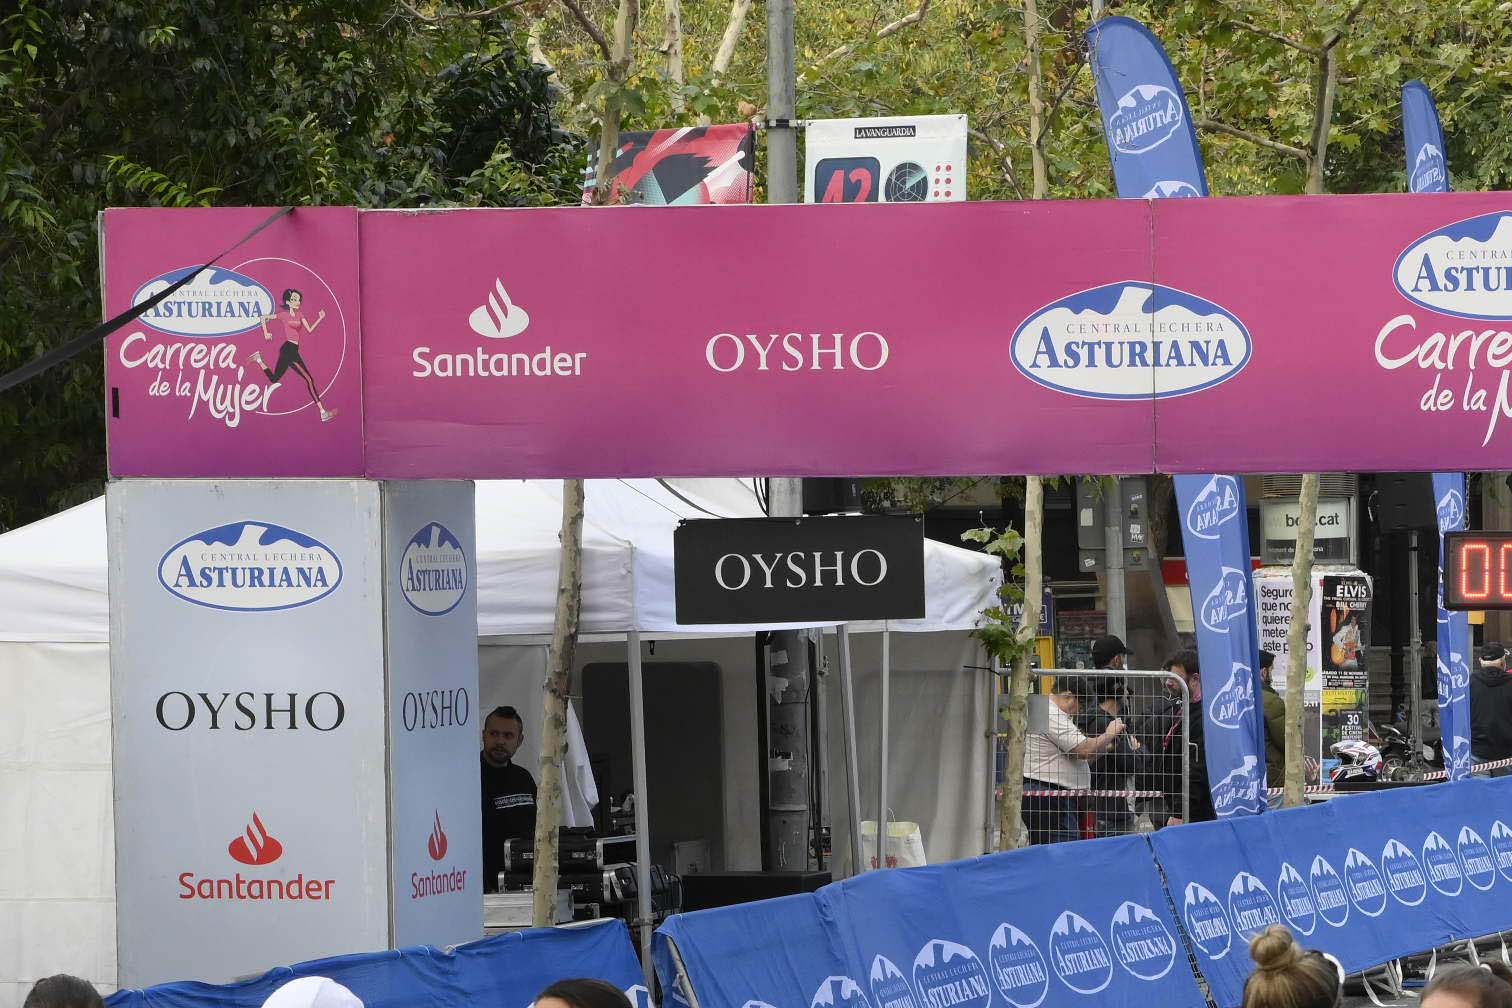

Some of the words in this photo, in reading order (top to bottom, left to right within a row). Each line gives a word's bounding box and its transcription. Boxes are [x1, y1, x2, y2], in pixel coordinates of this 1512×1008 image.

[865, 127, 915, 137] VANGUARDIA
[170, 289, 209, 298] ENTRAL
[1066, 322, 1142, 335] CENTRAL
[1149, 321, 1226, 334] LECHERA
[119, 332, 238, 370] Carrera
[412, 346, 587, 378] Santander
[705, 332, 890, 372] OYSHO
[1028, 326, 1233, 370] ASTURIANA
[149, 371, 171, 398] de
[175, 370, 192, 397] la
[187, 367, 282, 428] Mujer
[1420, 373, 1454, 412] de
[1463, 372, 1487, 412] la
[173, 555, 330, 589] ASTURIANA
[201, 552, 259, 562] CENTRAL
[264, 552, 323, 562] LECHERA
[715, 549, 888, 590] OYSHO
[405, 558, 464, 593] ASTURIANA
[1336, 585, 1367, 598] ELVIS
[1261, 602, 1278, 615] que
[1263, 641, 1281, 652] este
[156, 691, 346, 732] OYSHO
[402, 687, 469, 732] OYSHO
[1347, 714, 1360, 725] 30
[178, 872, 336, 901] Santander
[411, 867, 467, 901] Santander
[1055, 944, 1110, 977] ASTURIANA
